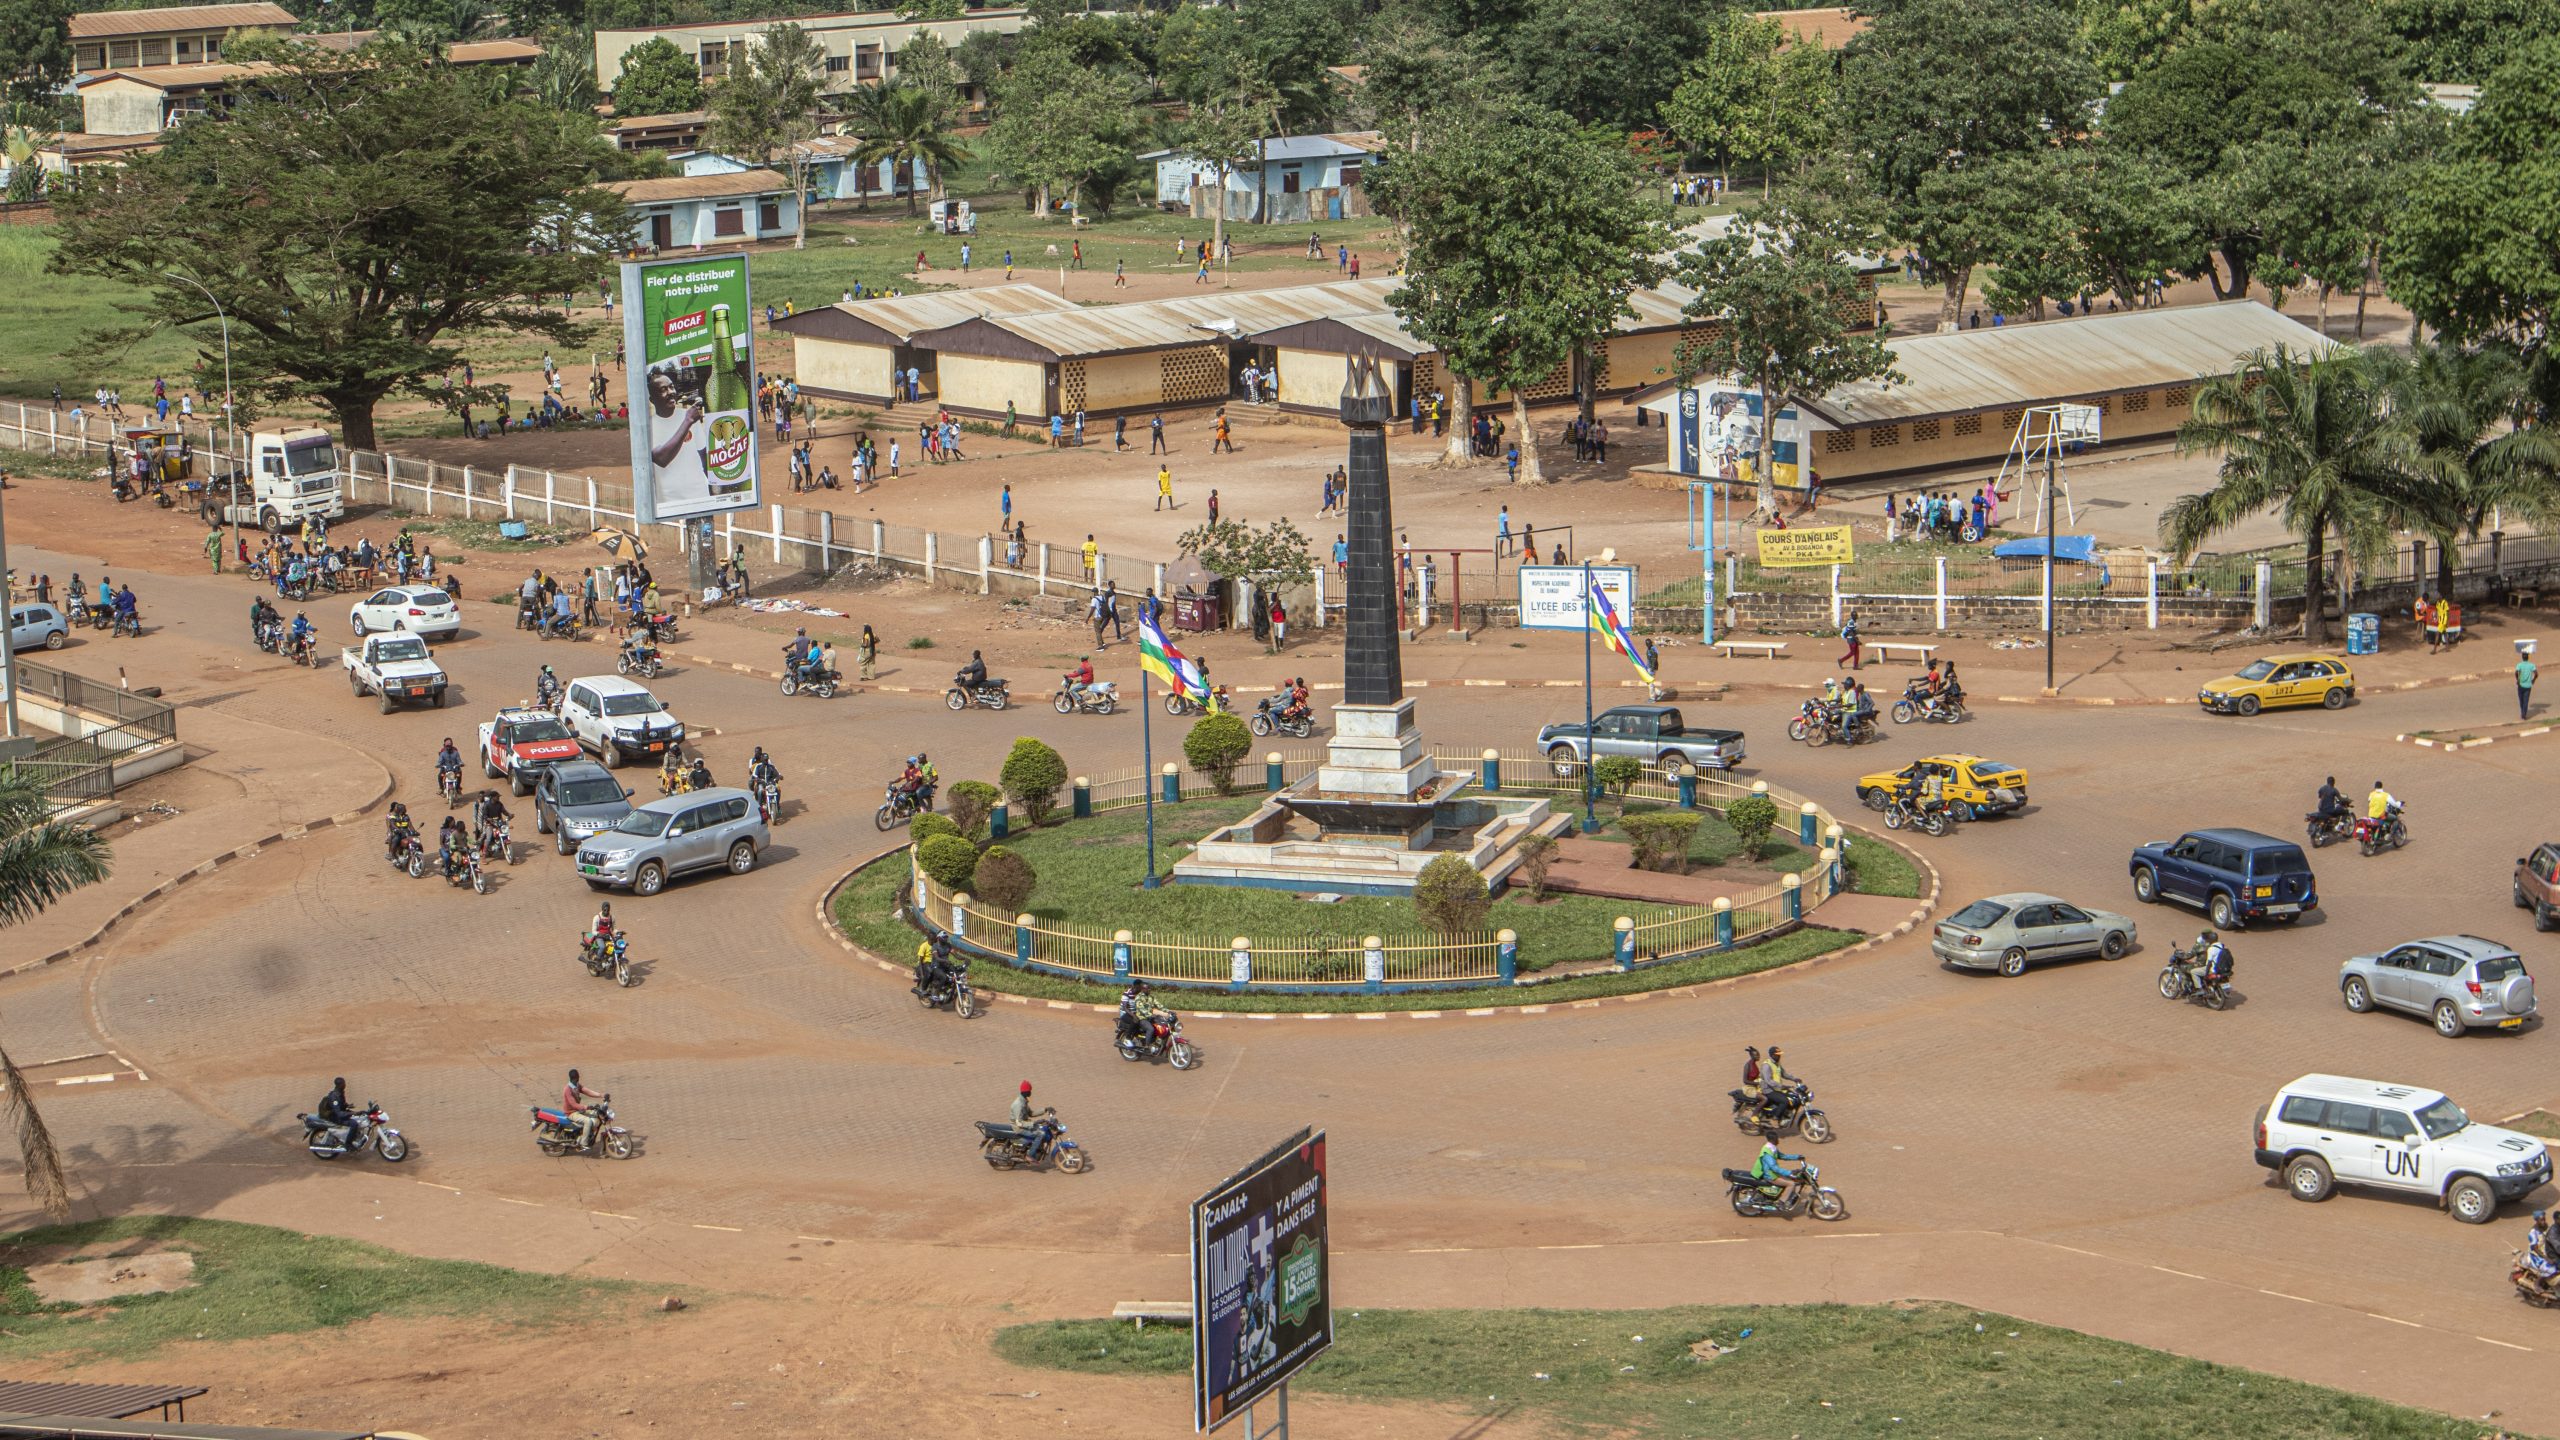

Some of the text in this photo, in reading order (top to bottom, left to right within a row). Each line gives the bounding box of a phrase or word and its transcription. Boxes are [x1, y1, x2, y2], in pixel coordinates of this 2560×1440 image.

[646, 269, 735, 287] Fier de distribuer
[665, 282, 718, 297] notre bière
[668, 315, 702, 333] MOCAF
[682, 333, 688, 341] de
[710, 437, 748, 465] MOCAF
[1763, 532, 1839, 544] COURS D'ANGLAIS
[1797, 543, 1824, 551] BOGANDA
[1530, 601, 1558, 611] LYCEE
[1562, 602, 1577, 611] DES
[530, 745, 569, 755] POLICE
[2497, 1137, 2534, 1151] UN
[2385, 1149, 2420, 1178] UN
[1276, 1175, 1319, 1216] Y A PIMENT
[1207, 1192, 1248, 1228] CANAL+
[1276, 1213, 1300, 1239] DANS
[1209, 1224, 1253, 1299] TOUJOURS
[1284, 1276, 1297, 1304] 15
[1296, 1264, 1317, 1285] JOURS
[1211, 1299, 1219, 1311] DE
[1212, 1311, 1219, 1322] DE
